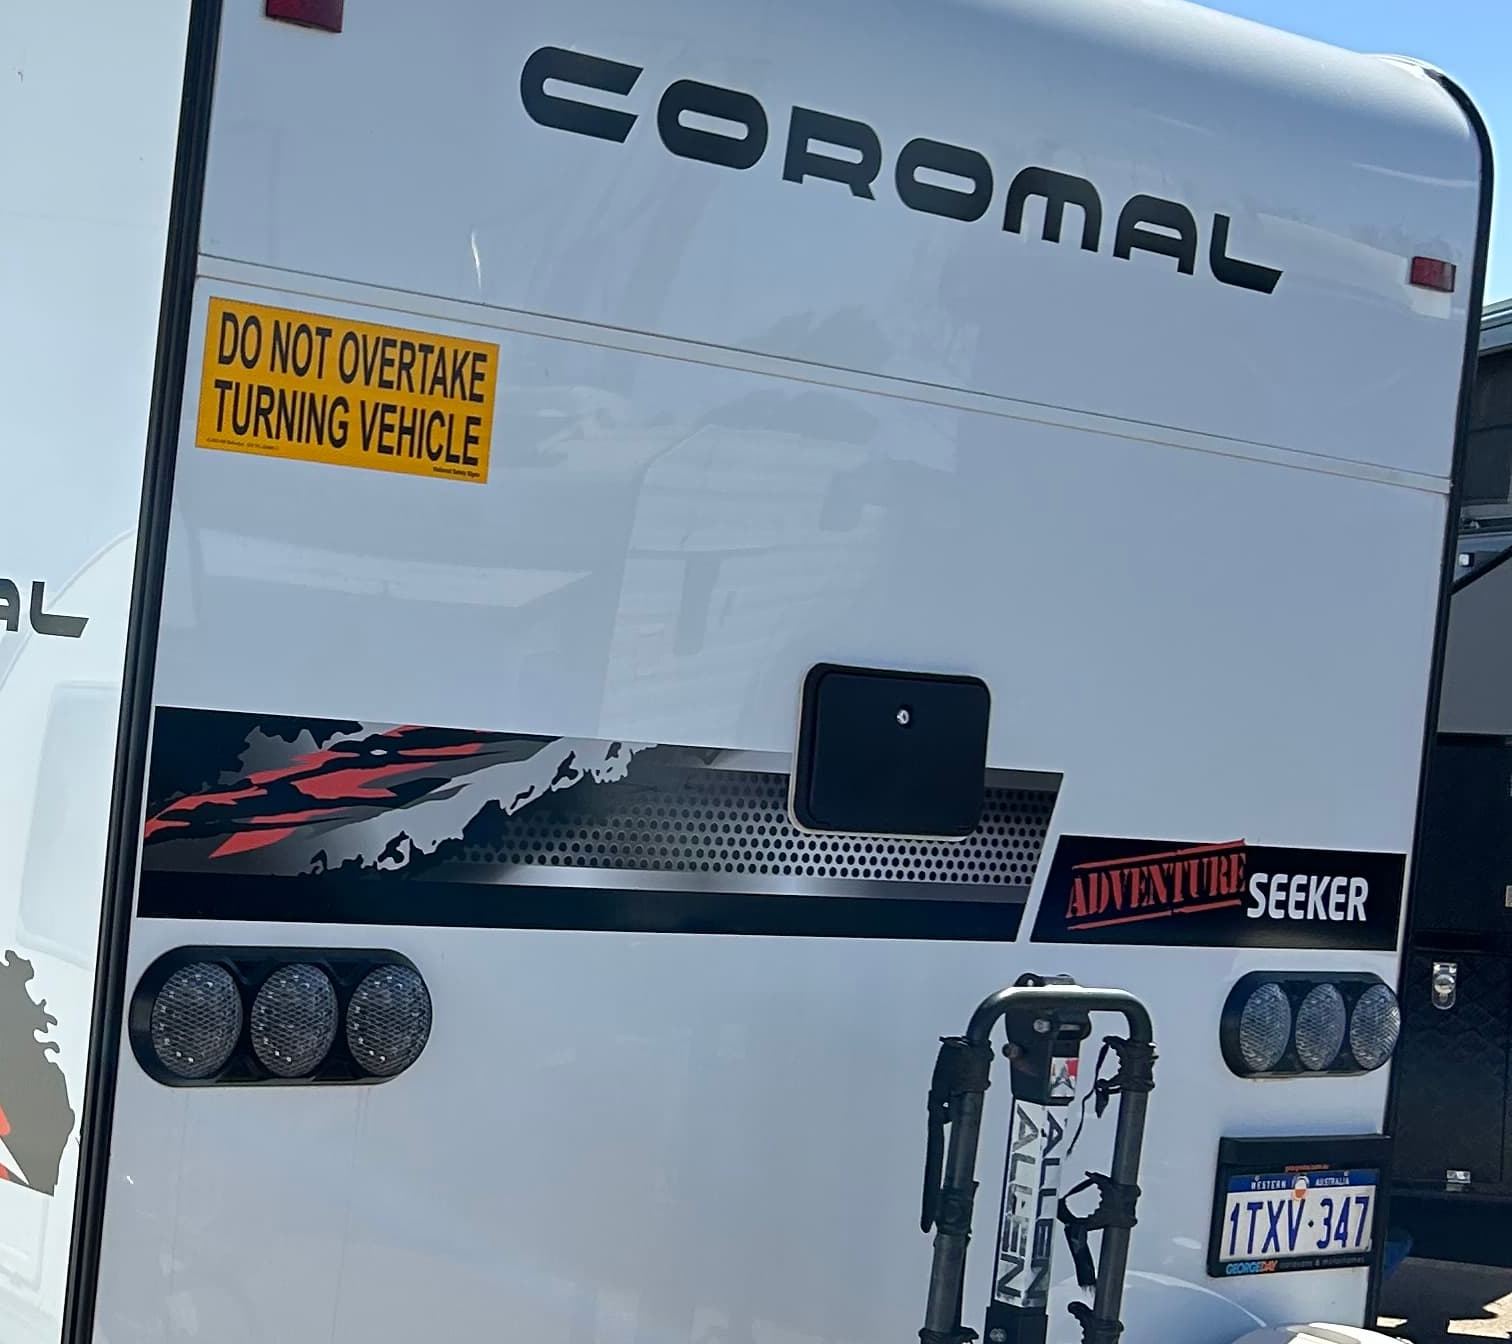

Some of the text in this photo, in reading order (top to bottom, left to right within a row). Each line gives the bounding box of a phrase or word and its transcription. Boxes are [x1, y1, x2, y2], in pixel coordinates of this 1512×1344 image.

[520, 45, 1284, 295] COROMAL
[217, 311, 488, 404] DO NOT OVERTAKE
[214, 378, 482, 467] TURNING VEHICLE
[1065, 852, 1369, 922] ADVENTURE SEEKER
[995, 1104, 1040, 1299] ALLEN
[1315, 1176, 1350, 1187] AUSTRALIA
